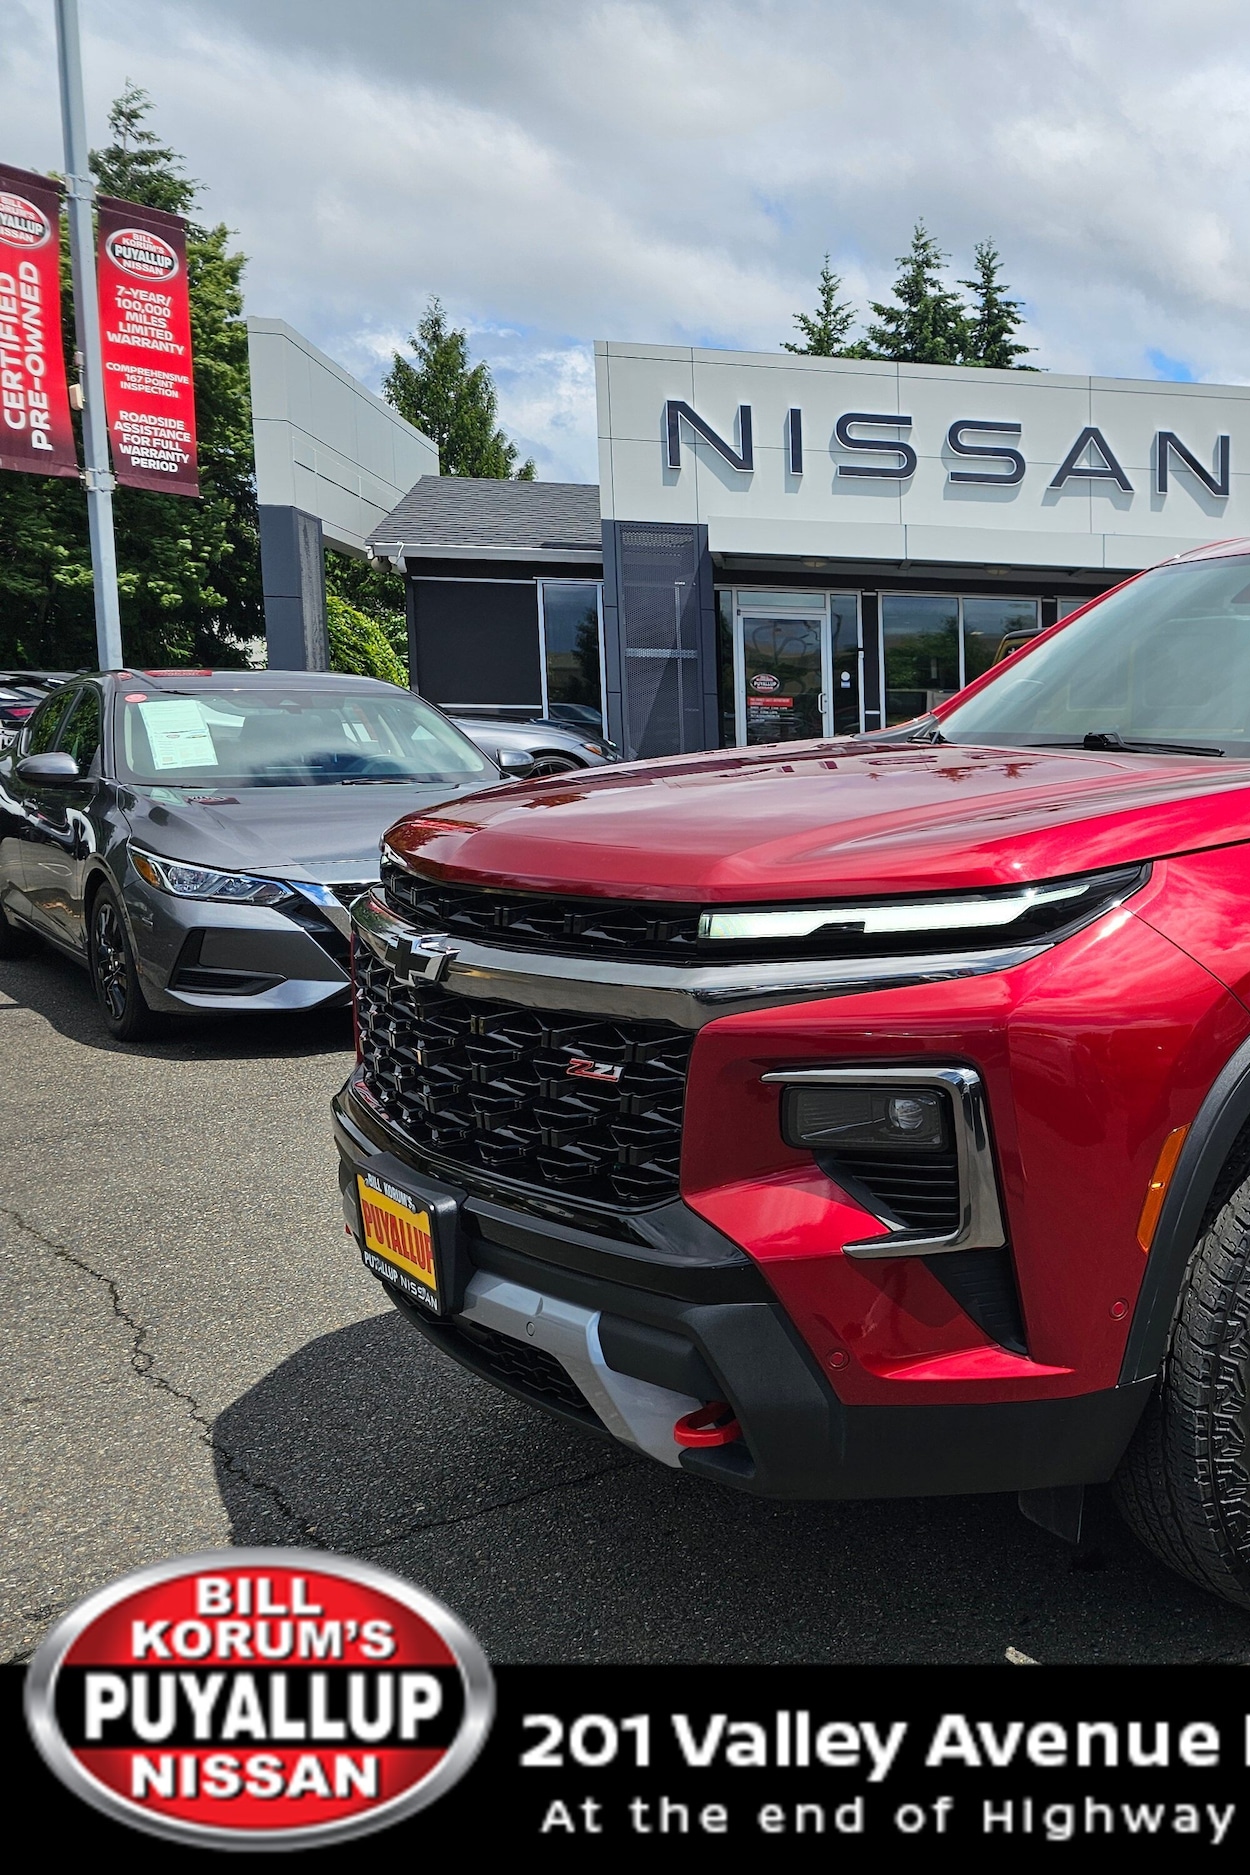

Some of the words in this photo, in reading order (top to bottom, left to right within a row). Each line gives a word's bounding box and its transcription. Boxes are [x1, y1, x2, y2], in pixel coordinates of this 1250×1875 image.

[0, 211, 44, 236] YALLUP
[0, 226, 34, 243] ISSAN
[132, 233, 153, 245] BILL
[122, 237, 165, 254] KORUM'S
[115, 244, 172, 269] PUYALLUP
[123, 260, 164, 275] NISSAN
[116, 285, 171, 306] 7-YEAR/
[115, 297, 171, 318] 100,000
[125, 311, 167, 328] MILES
[118, 322, 173, 341] LIMITED
[0, 272, 26, 430] CERTIFIED
[106, 331, 184, 355] WARRANTY
[19, 261, 54, 450] PRE-OWNED
[106, 362, 189, 384] COMPREHENSIVE
[125, 374, 143, 383] 167
[145, 377, 174, 389] POINT
[120, 381, 179, 398] INSPECTION
[119, 410, 185, 431] ROADSIDE
[114, 421, 191, 442] ASSISTANCE
[123, 433, 151, 447] FOR
[152, 438, 183, 452] FULL
[665, 400, 1230, 498] NISSAN
[119, 443, 189, 464] WARRANTY
[131, 456, 178, 473] PERIOD
[566, 1058, 624, 1082] Z71
[367, 1173, 382, 1193] BILL
[362, 1198, 434, 1275] PUYALLUP
[400, 1274, 438, 1310] NISSAN
